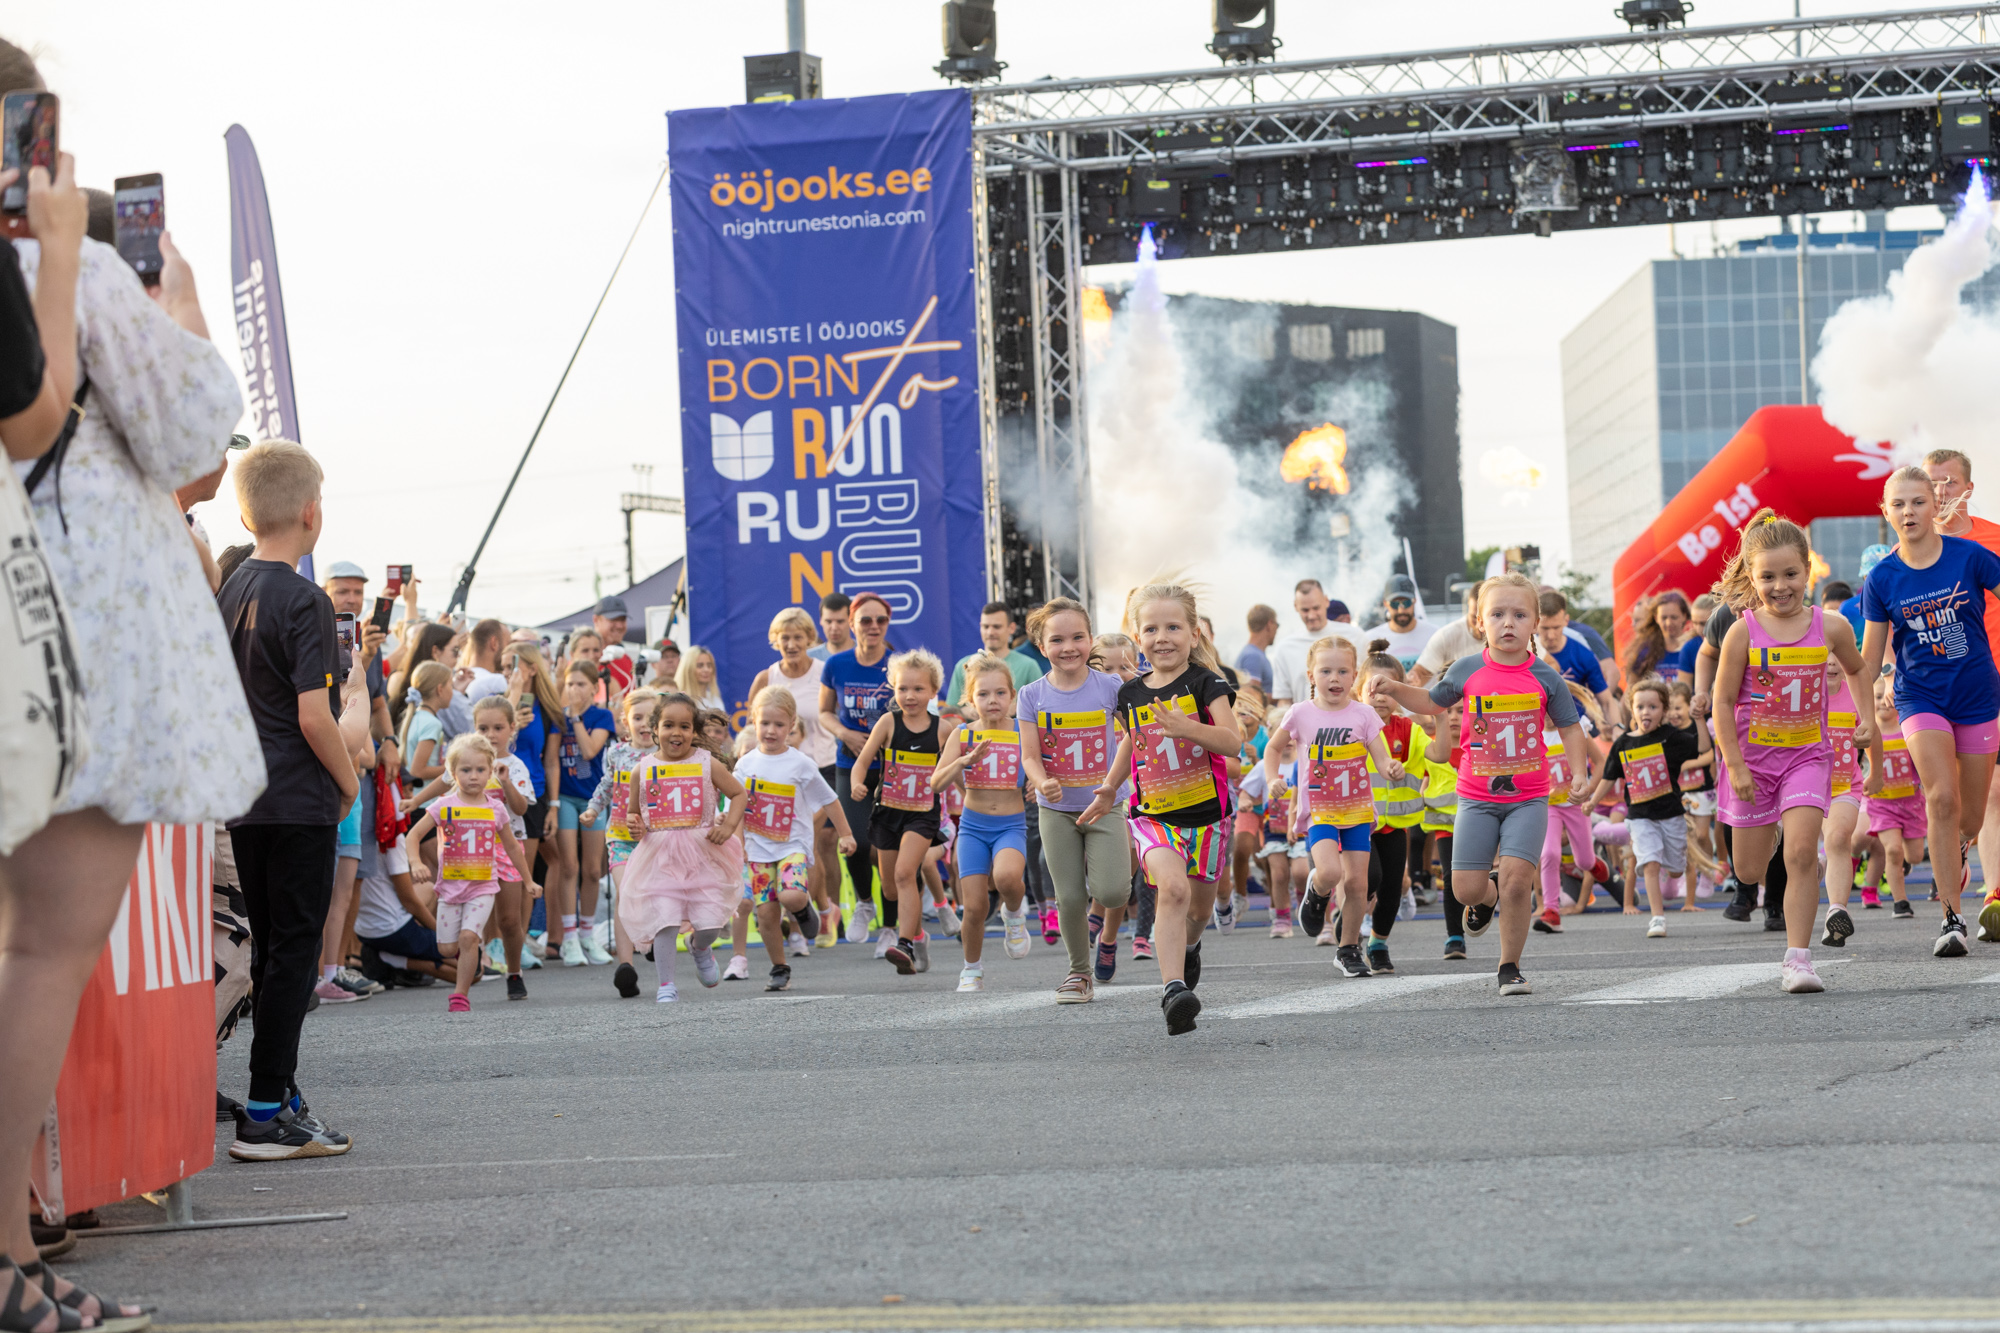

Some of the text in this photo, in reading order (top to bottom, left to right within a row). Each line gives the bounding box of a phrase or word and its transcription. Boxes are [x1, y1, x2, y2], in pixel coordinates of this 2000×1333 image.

[710, 166, 932, 212] ööjooks.ee
[722, 210, 926, 240] nightrunestonia.com
[706, 319, 906, 347] ÜLEMISTE ÖÖJOOKS
[706, 353, 859, 402] BORN
[1677, 482, 1760, 567] Be 1st
[1901, 598, 1942, 619] BORN
[1781, 678, 1801, 712] 1
[1315, 727, 1353, 746] NIKE
[1495, 724, 1516, 757] 1
[982, 752, 998, 779] 1
[1064, 740, 1083, 770] 1
[1155, 736, 1180, 771] 1
[901, 774, 917, 798] 1
[1333, 769, 1350, 797] 1
[1637, 766, 1653, 789] 1
[667, 786, 682, 813] 1
[760, 803, 775, 827] 1
[461, 829, 476, 854] 1
